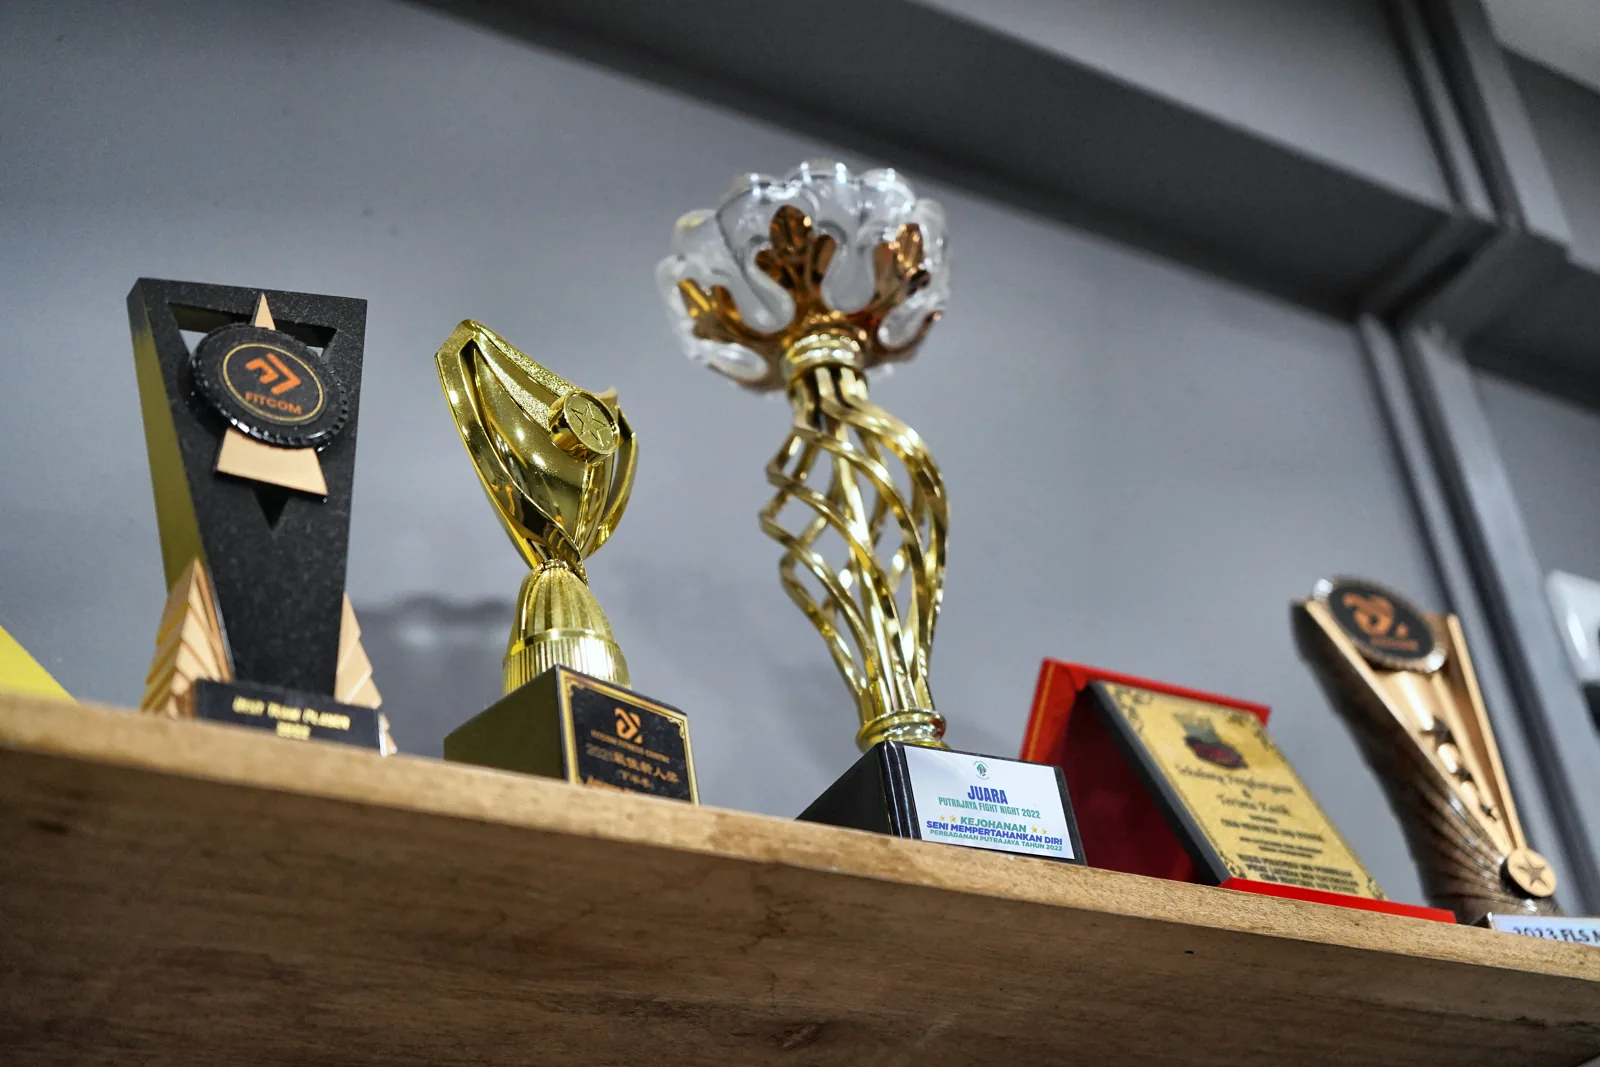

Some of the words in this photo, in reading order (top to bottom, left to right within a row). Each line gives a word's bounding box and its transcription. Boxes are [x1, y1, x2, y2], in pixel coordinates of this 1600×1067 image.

[245, 392, 303, 415] FITCOM
[967, 785, 1008, 805] JUARA
[938, 796, 977, 811] PUTRAJAYA
[979, 802, 997, 814] FIGHT
[1000, 804, 1020, 816] NIGHT
[1021, 808, 1041, 819] 2022
[926, 820, 949, 831] SENI
[950, 824, 1043, 843] MEMPERTAHANKAN
[1044, 835, 1063, 846] DIRI
[960, 816, 1027, 833] KEJOHANAN
[929, 828, 978, 841] PERBADANAN
[979, 835, 1021, 847] PUTRAJAYA
[1021, 840, 1045, 850] TAHUN
[1045, 844, 1063, 852] 2022
[1559, 928, 1590, 943] FLS
